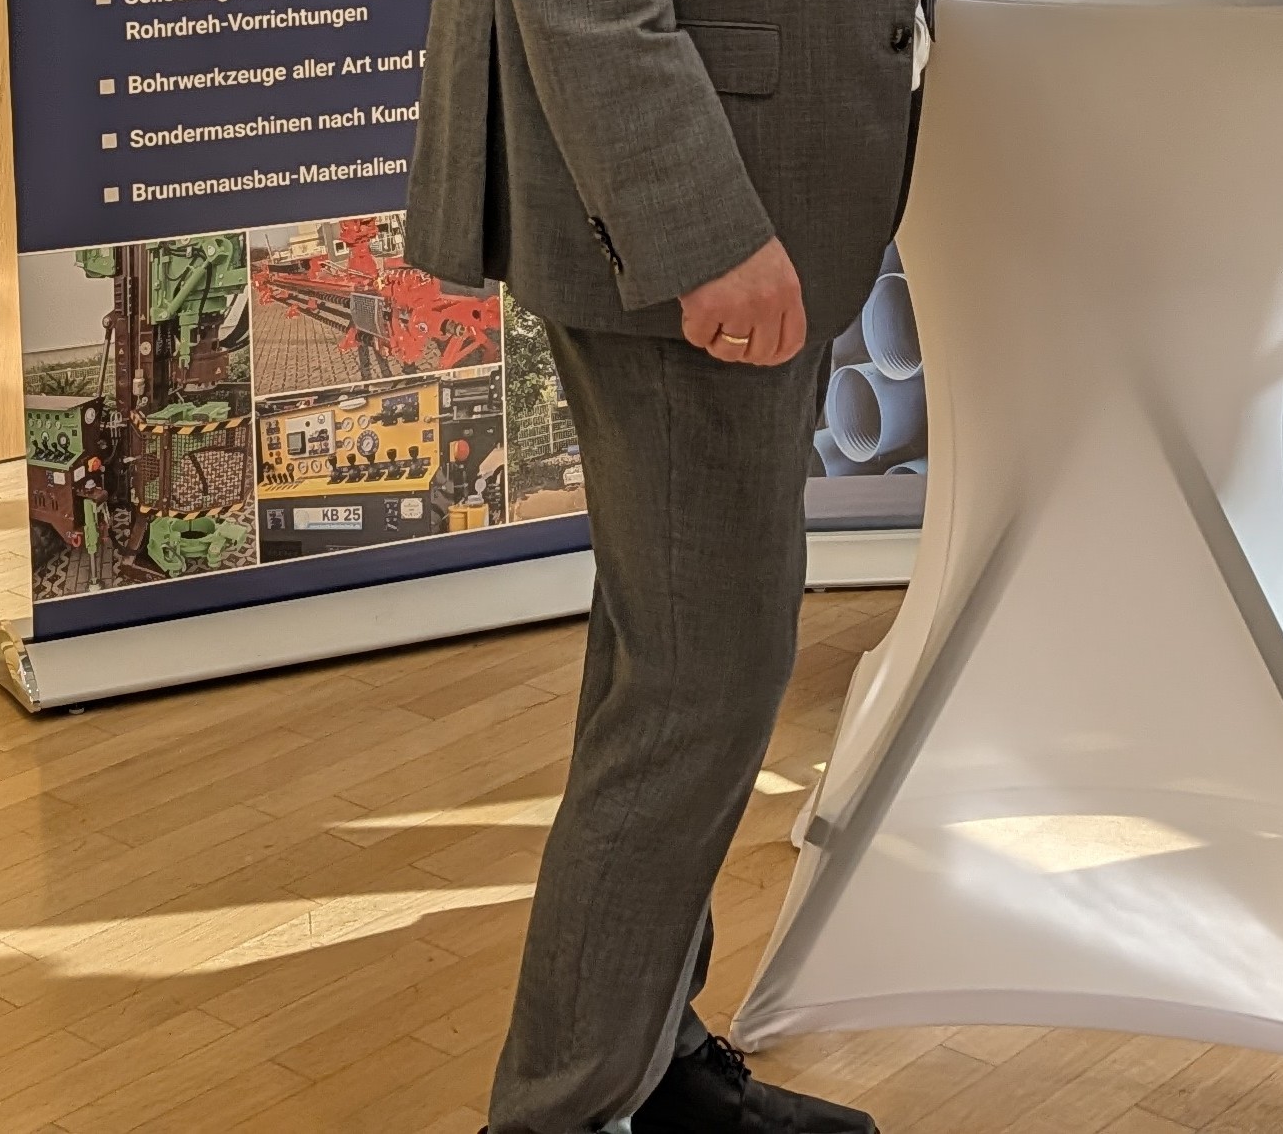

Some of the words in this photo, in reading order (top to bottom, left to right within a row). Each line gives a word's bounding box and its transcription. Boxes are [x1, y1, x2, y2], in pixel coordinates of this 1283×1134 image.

[125, 5, 368, 40] Rohrdreh-Vorrichtungen
[128, 66, 287, 95] Bohrwerkzeuge
[292, 58, 336, 80] aller
[341, 55, 373, 75] Art
[377, 49, 413, 72] und
[129, 115, 313, 148] Sondermaschinen
[318, 107, 366, 130] nach
[371, 101, 420, 124] Kund
[132, 156, 408, 202] Brunnenausbau-Materialien
[322, 508, 340, 522] KB
[343, 507, 361, 522] 25
